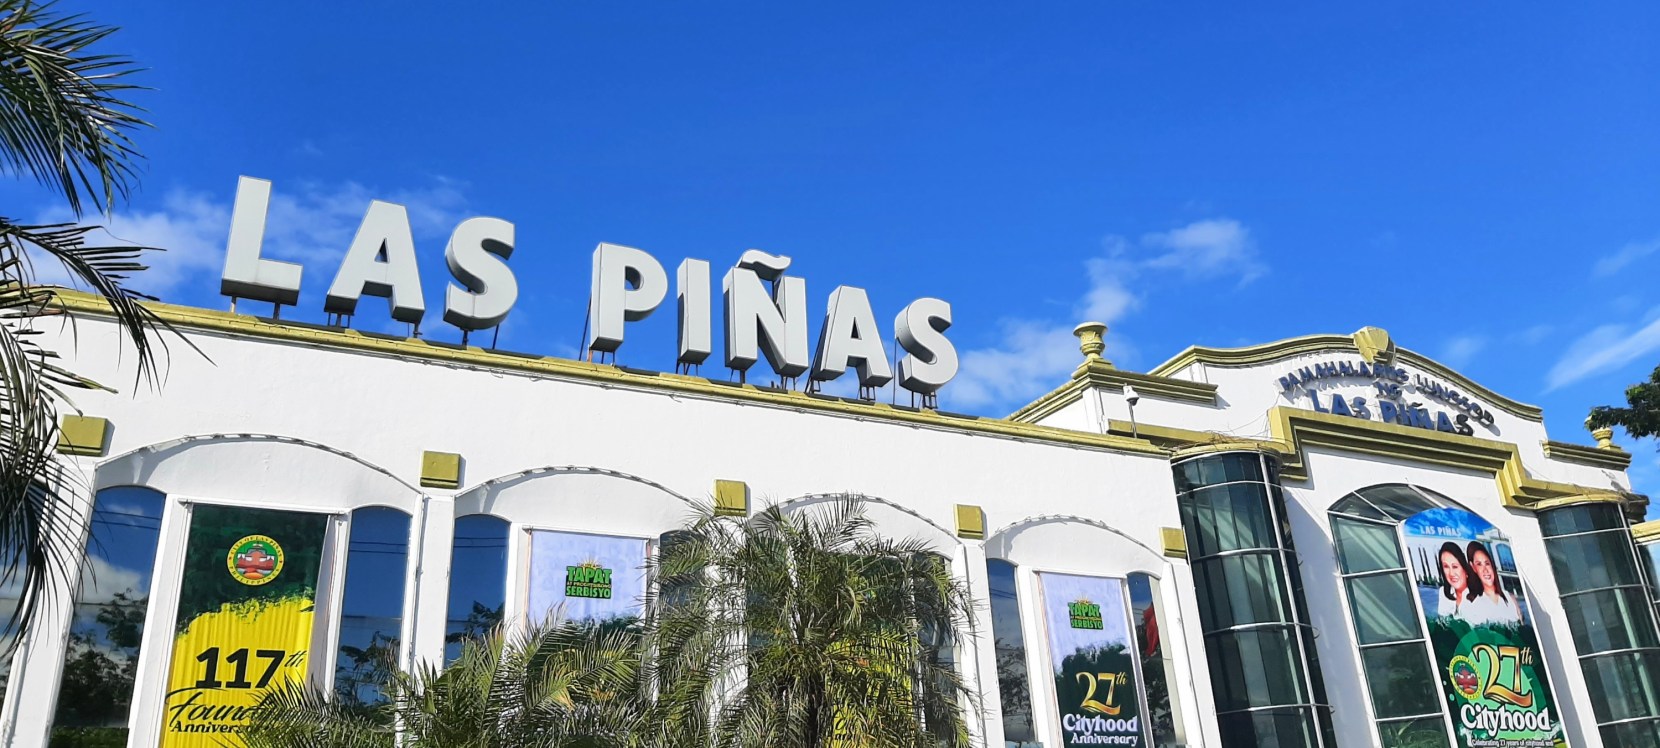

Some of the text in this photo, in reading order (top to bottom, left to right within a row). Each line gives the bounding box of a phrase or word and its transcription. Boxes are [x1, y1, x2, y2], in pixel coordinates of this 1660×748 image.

[221, 175, 958, 394] LAS PIÑAS
[1374, 381, 1402, 400] NG
[1415, 374, 1494, 426] LUNGSOD
[1311, 389, 1473, 436] LAS PIÑAS
[1420, 525, 1435, 535] LAS
[566, 566, 612, 584] TAPAT
[566, 586, 611, 598] SERBISYO
[1068, 602, 1100, 617] TAPAT
[1071, 619, 1103, 629] SERBISYO
[195, 646, 307, 688] 117th
[1472, 644, 1534, 708] 27th
[1076, 671, 1127, 715] 27th
[1063, 713, 1138, 736] Cityhood
[1460, 703, 1551, 737] Cityhood
[1071, 732, 1138, 747] Anniversary
